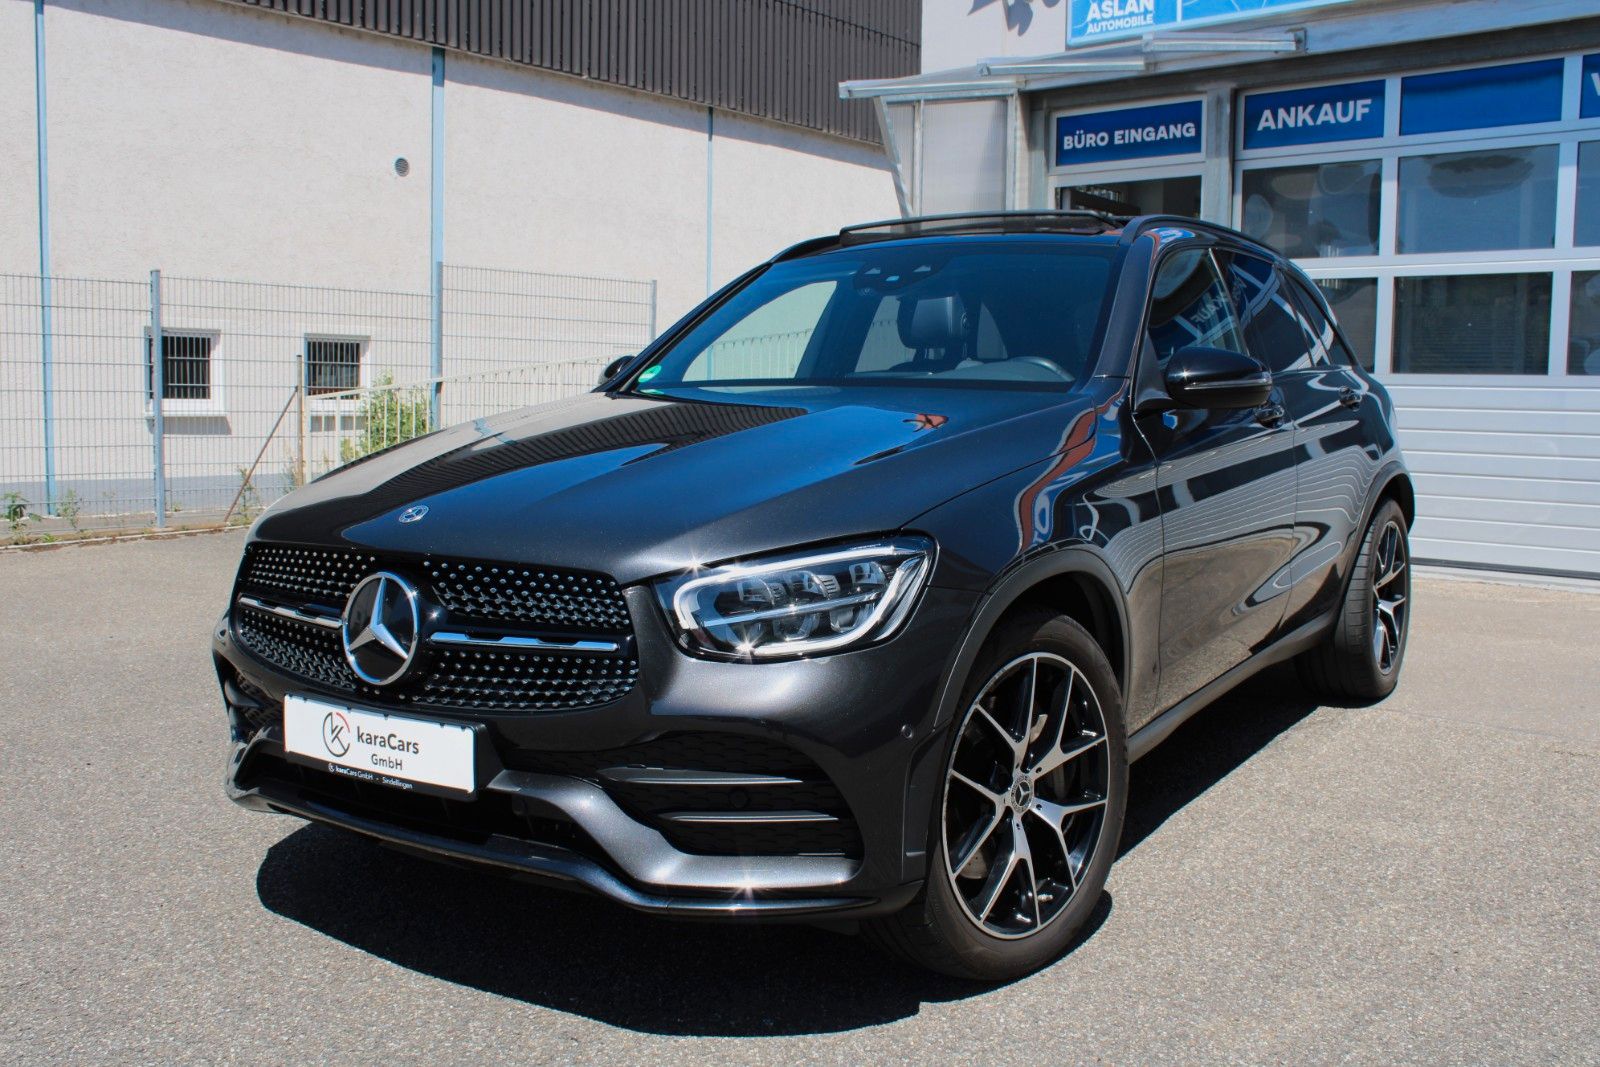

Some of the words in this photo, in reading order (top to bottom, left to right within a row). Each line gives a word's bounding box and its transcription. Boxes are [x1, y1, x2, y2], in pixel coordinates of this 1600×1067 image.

[1087, 0, 1154, 21] ASLAN
[1086, 13, 1154, 34] AUTOMOBILE
[1256, 98, 1372, 131] ANKAUF
[1063, 130, 1109, 150] BÜRO
[1113, 122, 1196, 145] EINGANG
[356, 725, 420, 755] karaCars
[335, 764, 357, 777] karaCars
[357, 770, 374, 781] GmbH
[371, 753, 403, 771] GmbH
